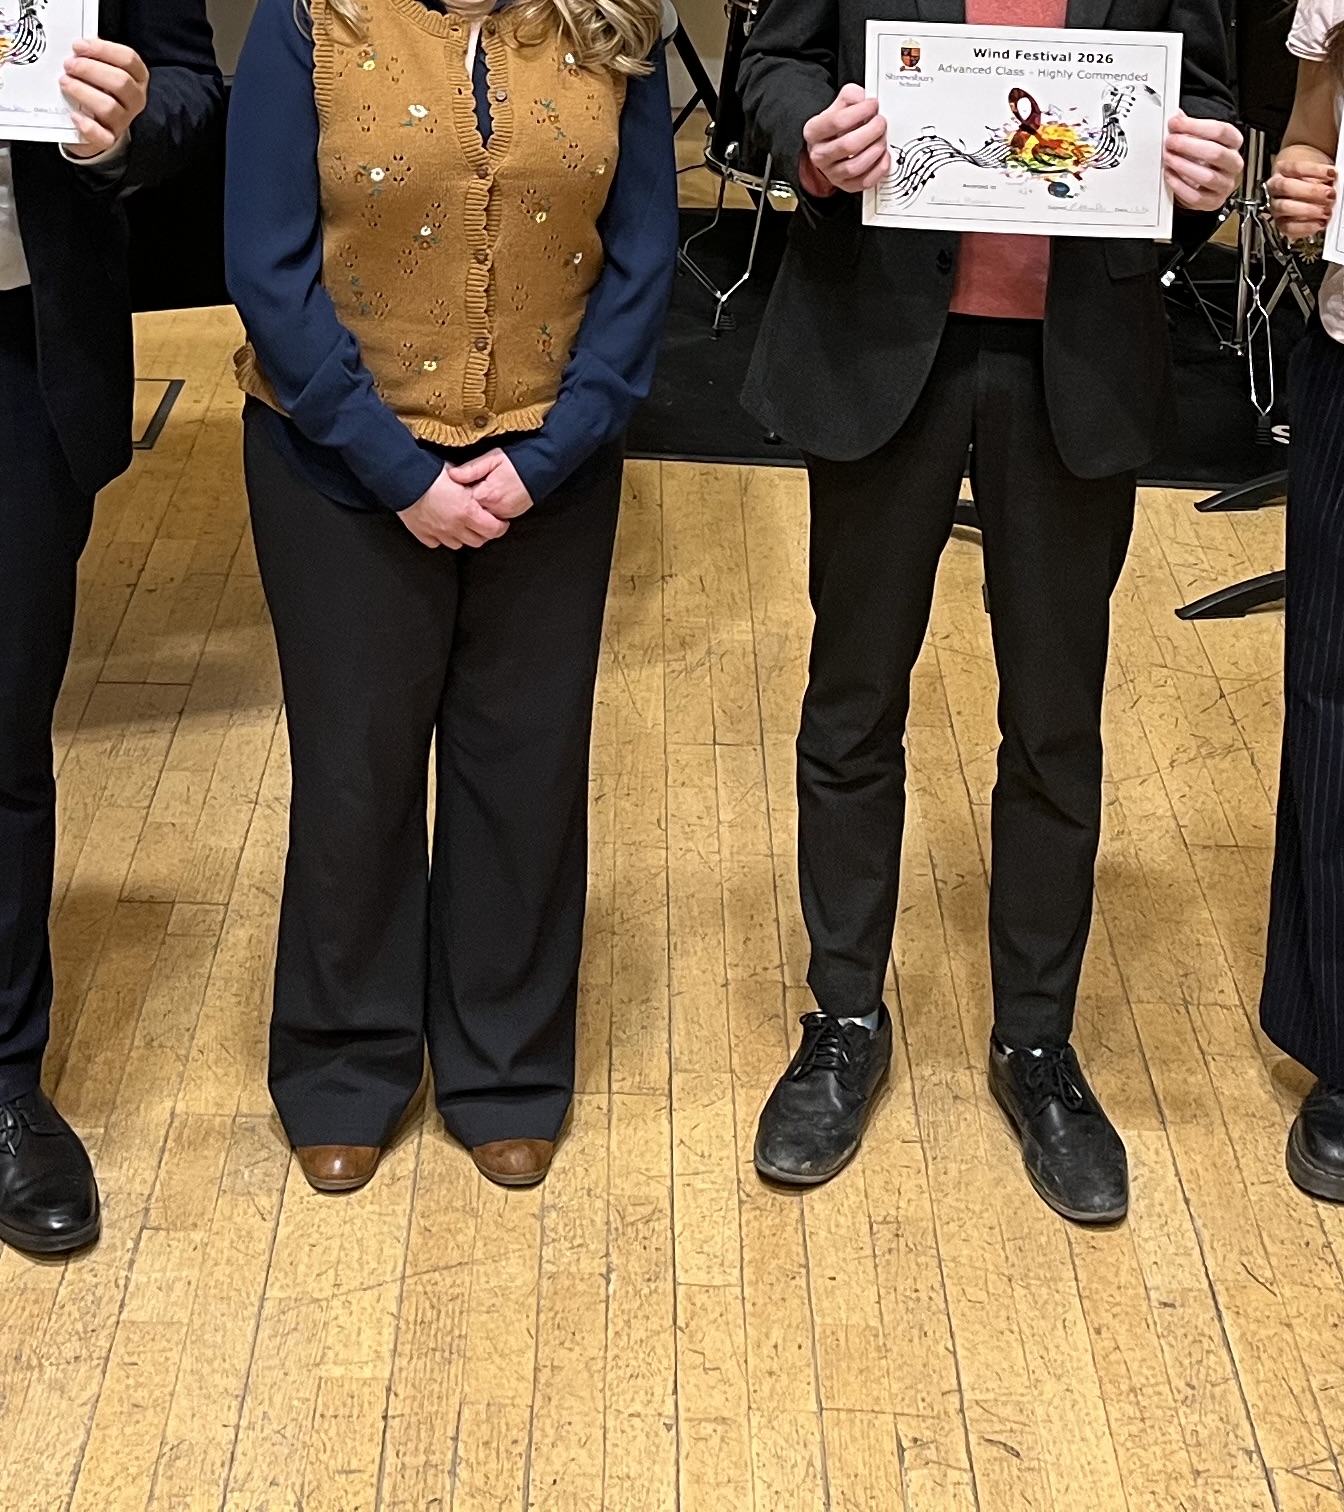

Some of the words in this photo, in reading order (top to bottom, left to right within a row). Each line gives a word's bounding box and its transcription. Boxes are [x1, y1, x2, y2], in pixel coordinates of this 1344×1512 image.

[973, 48, 1010, 59] Wind
[1015, 50, 1072, 62] Festival
[1077, 53, 1114, 64] 2026
[937, 63, 992, 75] Advanced
[996, 66, 1025, 76] Class
[1038, 68, 1073, 81] Highly
[1077, 70, 1148, 82] Commended
